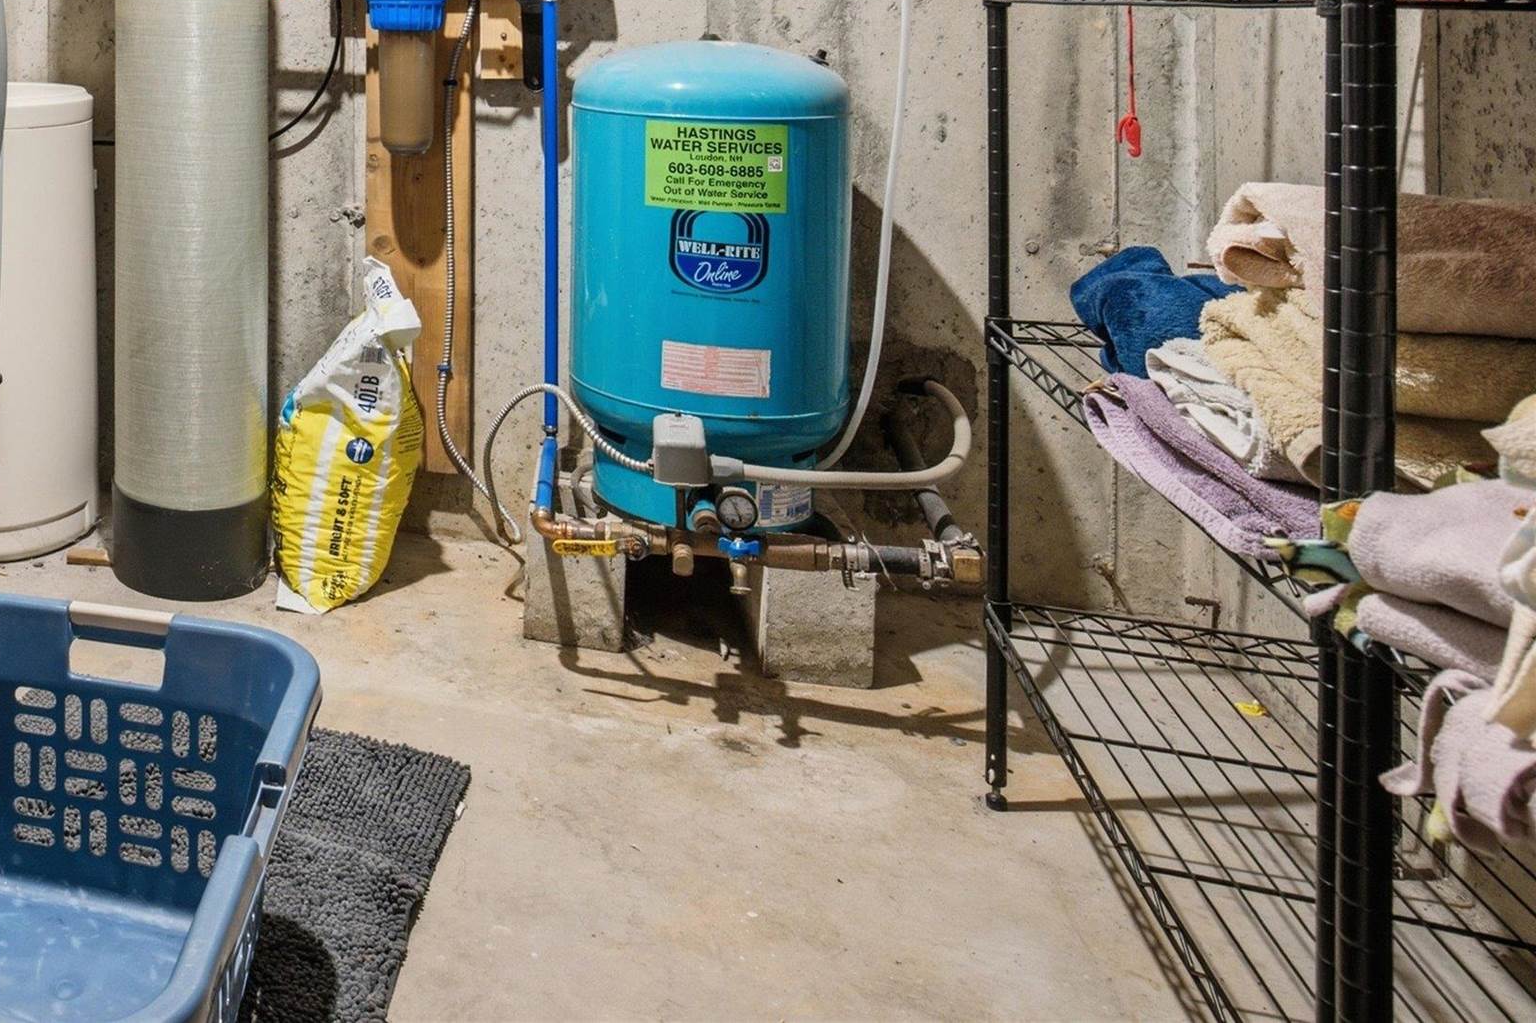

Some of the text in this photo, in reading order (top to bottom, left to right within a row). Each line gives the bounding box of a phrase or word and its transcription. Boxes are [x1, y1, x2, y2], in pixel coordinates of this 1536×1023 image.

[676, 127, 757, 142] HASTINGS
[650, 138, 783, 155] WATER SERVICES
[728, 155, 743, 163] NH
[668, 162, 764, 178] 603-608-6885
[665, 176, 767, 191] Call For Emergency
[663, 186, 769, 200] Out of Water Service
[677, 239, 761, 260] WELL-RITE
[694, 261, 742, 284] Online
[357, 374, 380, 414] 40LB
[337, 475, 353, 507] SOFT
[335, 508, 347, 518] &
